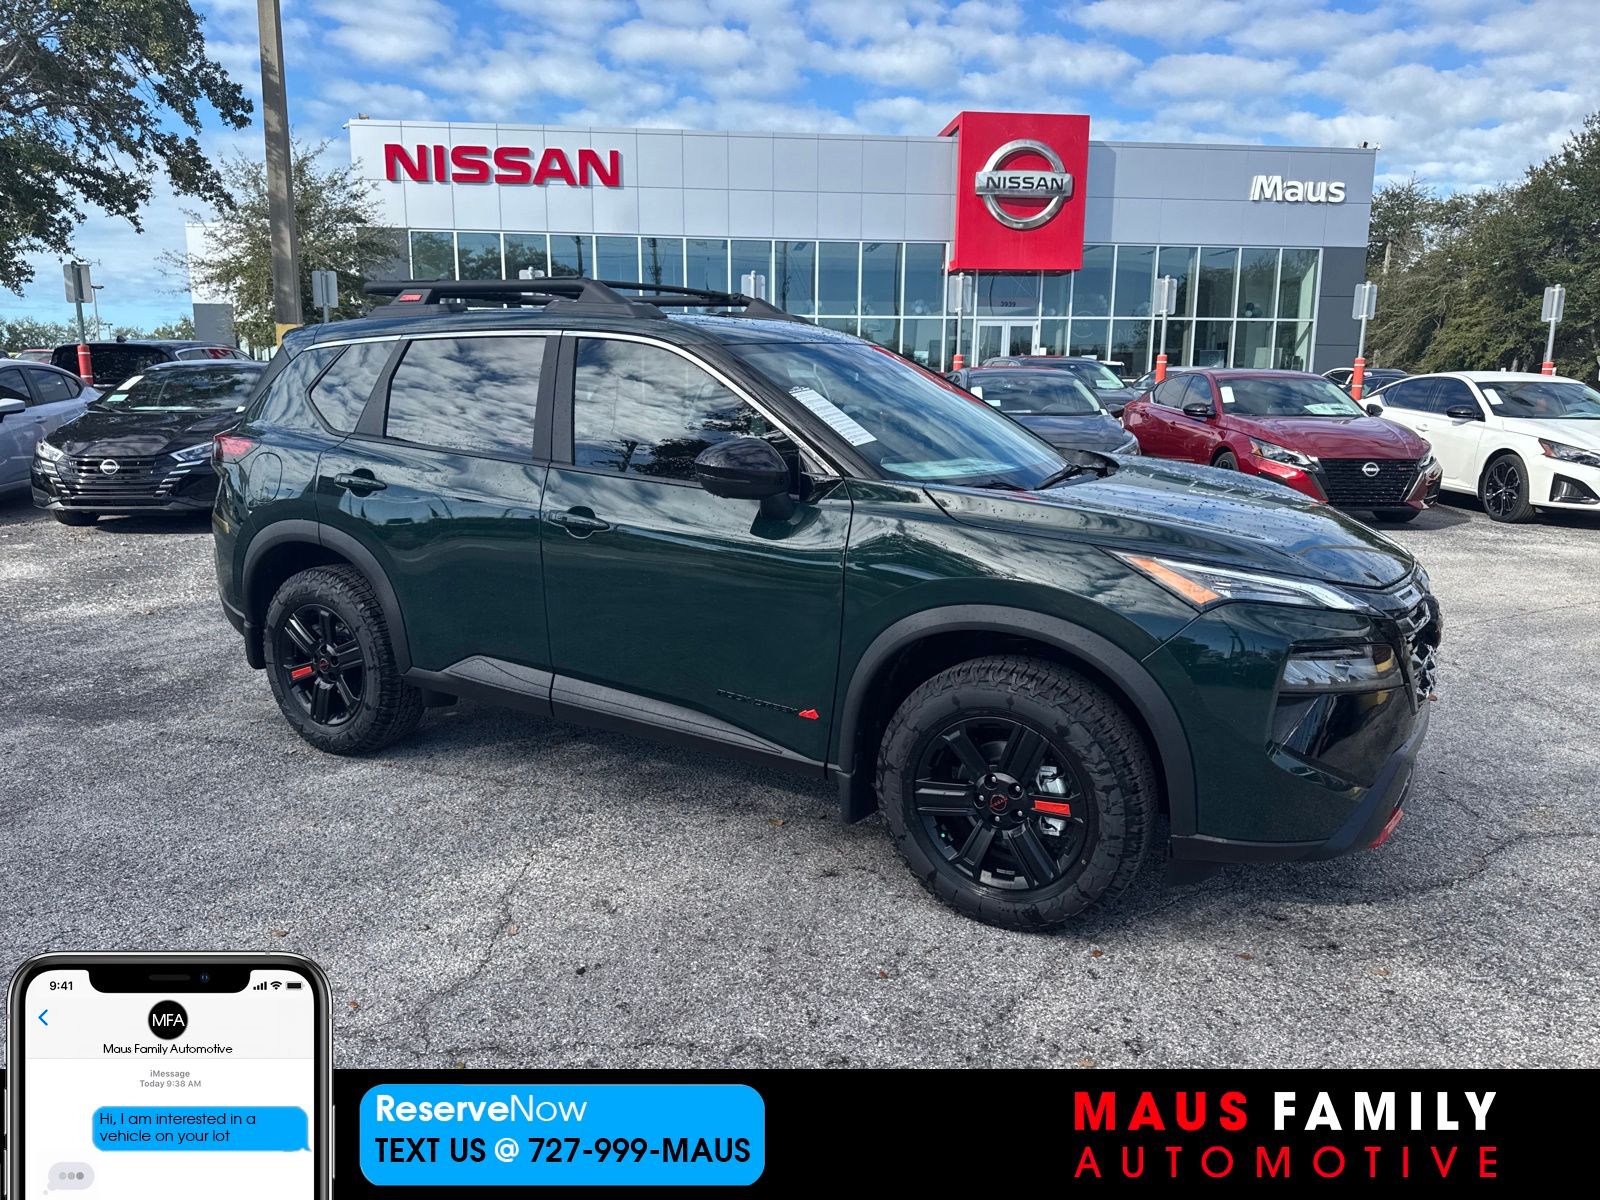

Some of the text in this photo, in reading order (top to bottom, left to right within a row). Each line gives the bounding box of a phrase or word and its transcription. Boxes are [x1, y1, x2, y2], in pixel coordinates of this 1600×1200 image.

[385, 143, 620, 187] NISSAN
[986, 176, 1064, 190] NISSAN
[1250, 174, 1346, 203] Maus
